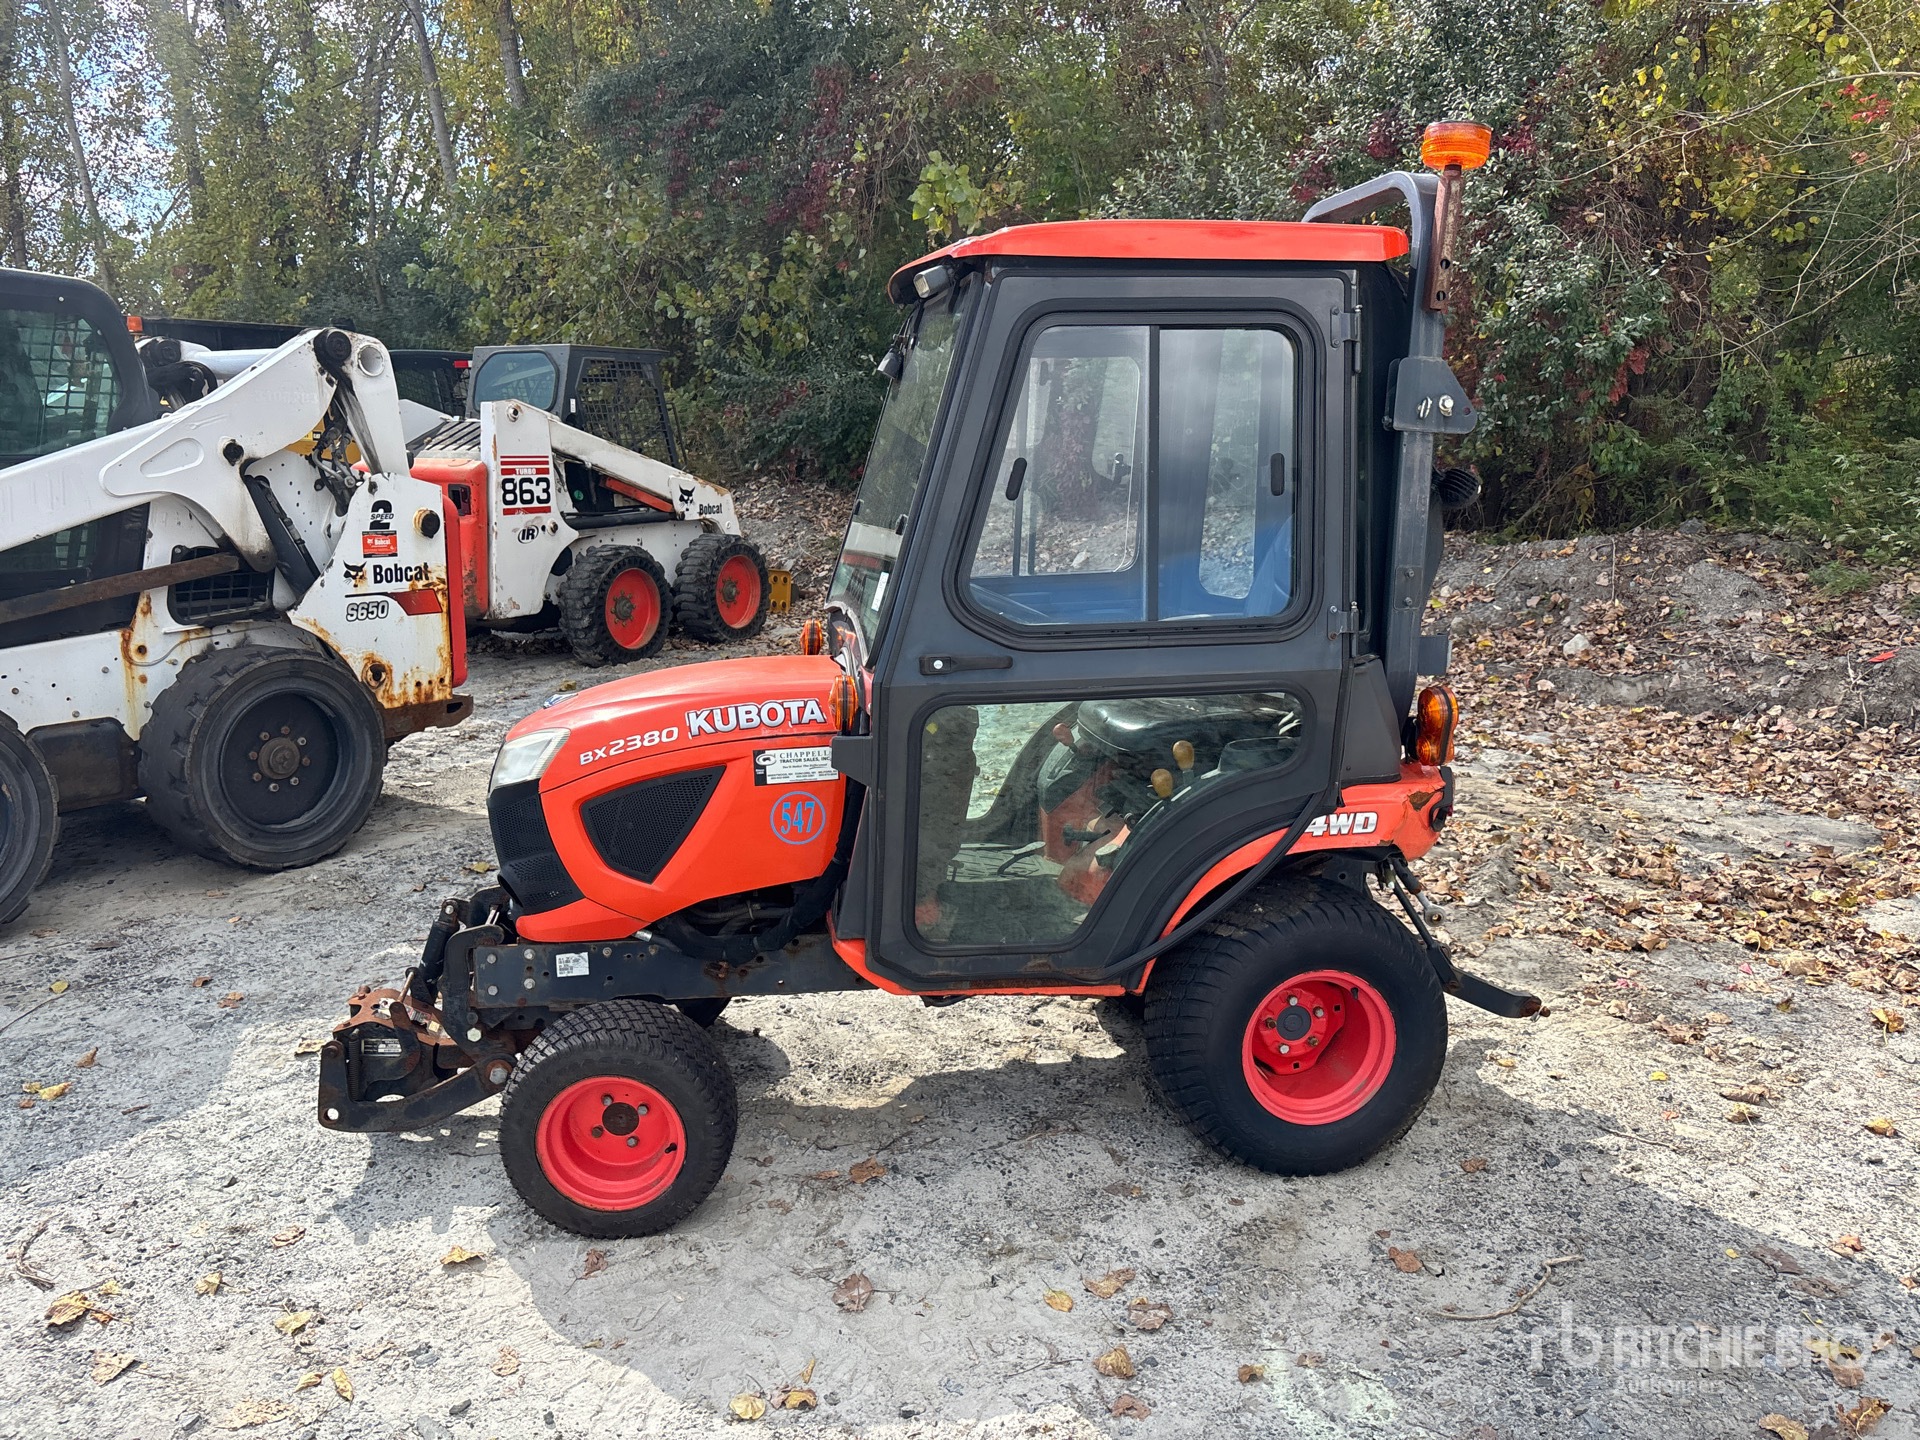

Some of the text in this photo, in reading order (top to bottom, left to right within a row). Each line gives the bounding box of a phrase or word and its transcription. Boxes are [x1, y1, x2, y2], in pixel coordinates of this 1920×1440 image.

[501, 477, 551, 505] 863
[369, 500, 393, 530] 2
[699, 503, 722, 515] Bobcat
[520, 528, 537, 540] IR
[373, 562, 430, 584] Bobcat
[346, 600, 389, 622] S650
[688, 699, 827, 738] KUBOTA
[580, 727, 679, 766] BX2380
[779, 750, 830, 759] CHAPPELL
[780, 801, 815, 835] 547
[1304, 812, 1378, 837] 4WD
